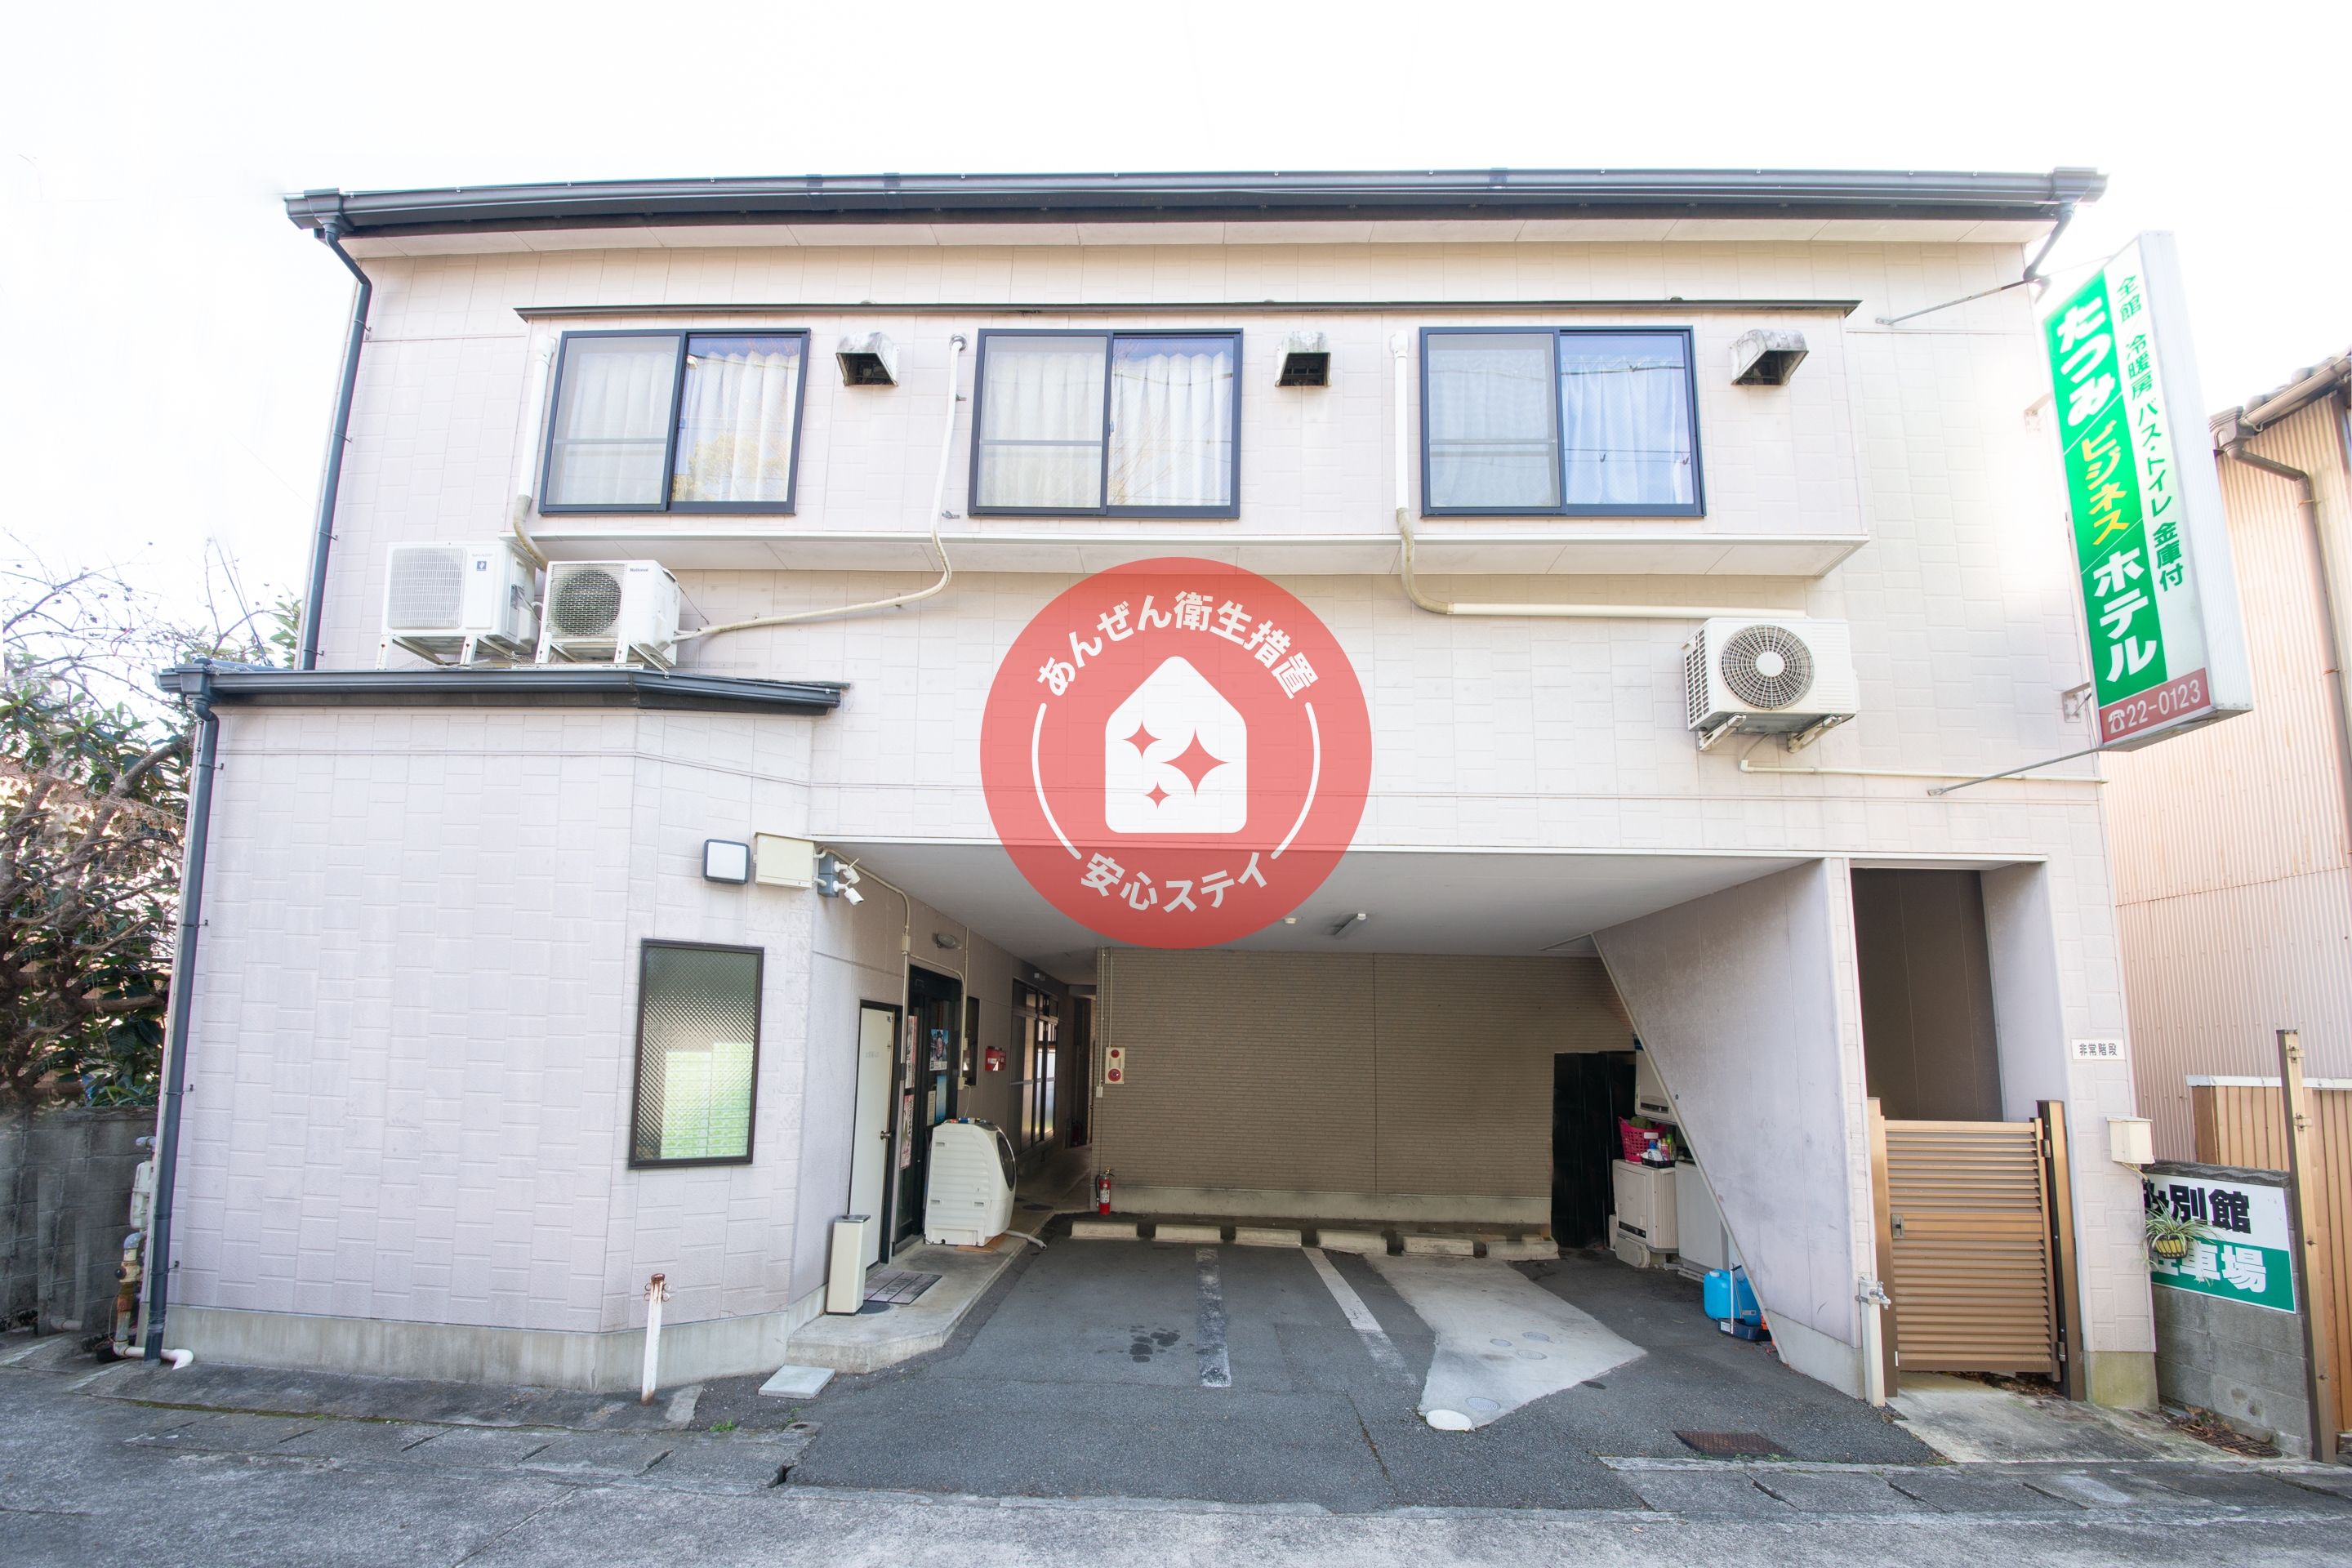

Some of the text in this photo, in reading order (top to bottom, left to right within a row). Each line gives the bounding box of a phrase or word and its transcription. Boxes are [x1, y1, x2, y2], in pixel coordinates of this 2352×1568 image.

[2116, 274, 2184, 592] 全館 冷暖房 バス・トイレ 金庫付
[2056, 296, 2157, 682] たつみ ビジネス ホテル
[2126, 679, 2201, 728] 22-0123
[2078, 1042, 2118, 1057] 非常階段
[879, 1276, 914, 1295] HOME
